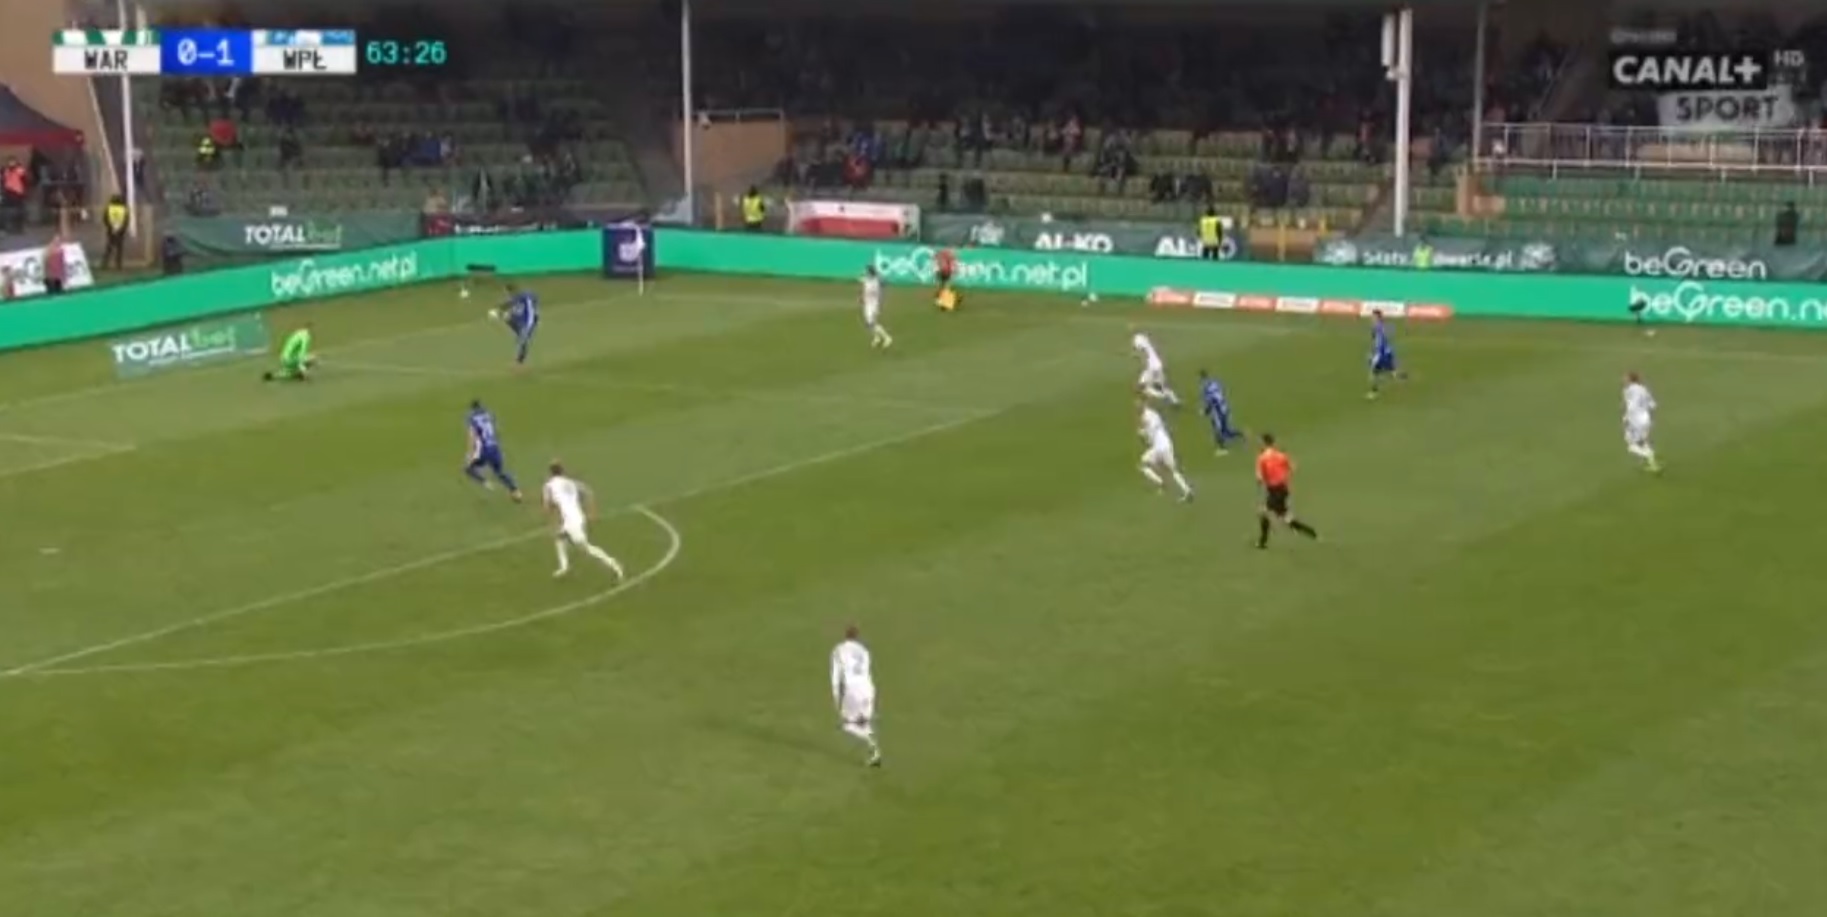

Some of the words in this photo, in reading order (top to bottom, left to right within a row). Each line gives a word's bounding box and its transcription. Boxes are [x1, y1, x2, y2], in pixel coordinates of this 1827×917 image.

[1154, 236, 1238, 261] AL-O
[1624, 246, 1767, 279] beGreen
[874, 248, 1087, 289] beGeen.net.pl
[1629, 280, 1827, 323] beGreen.n
